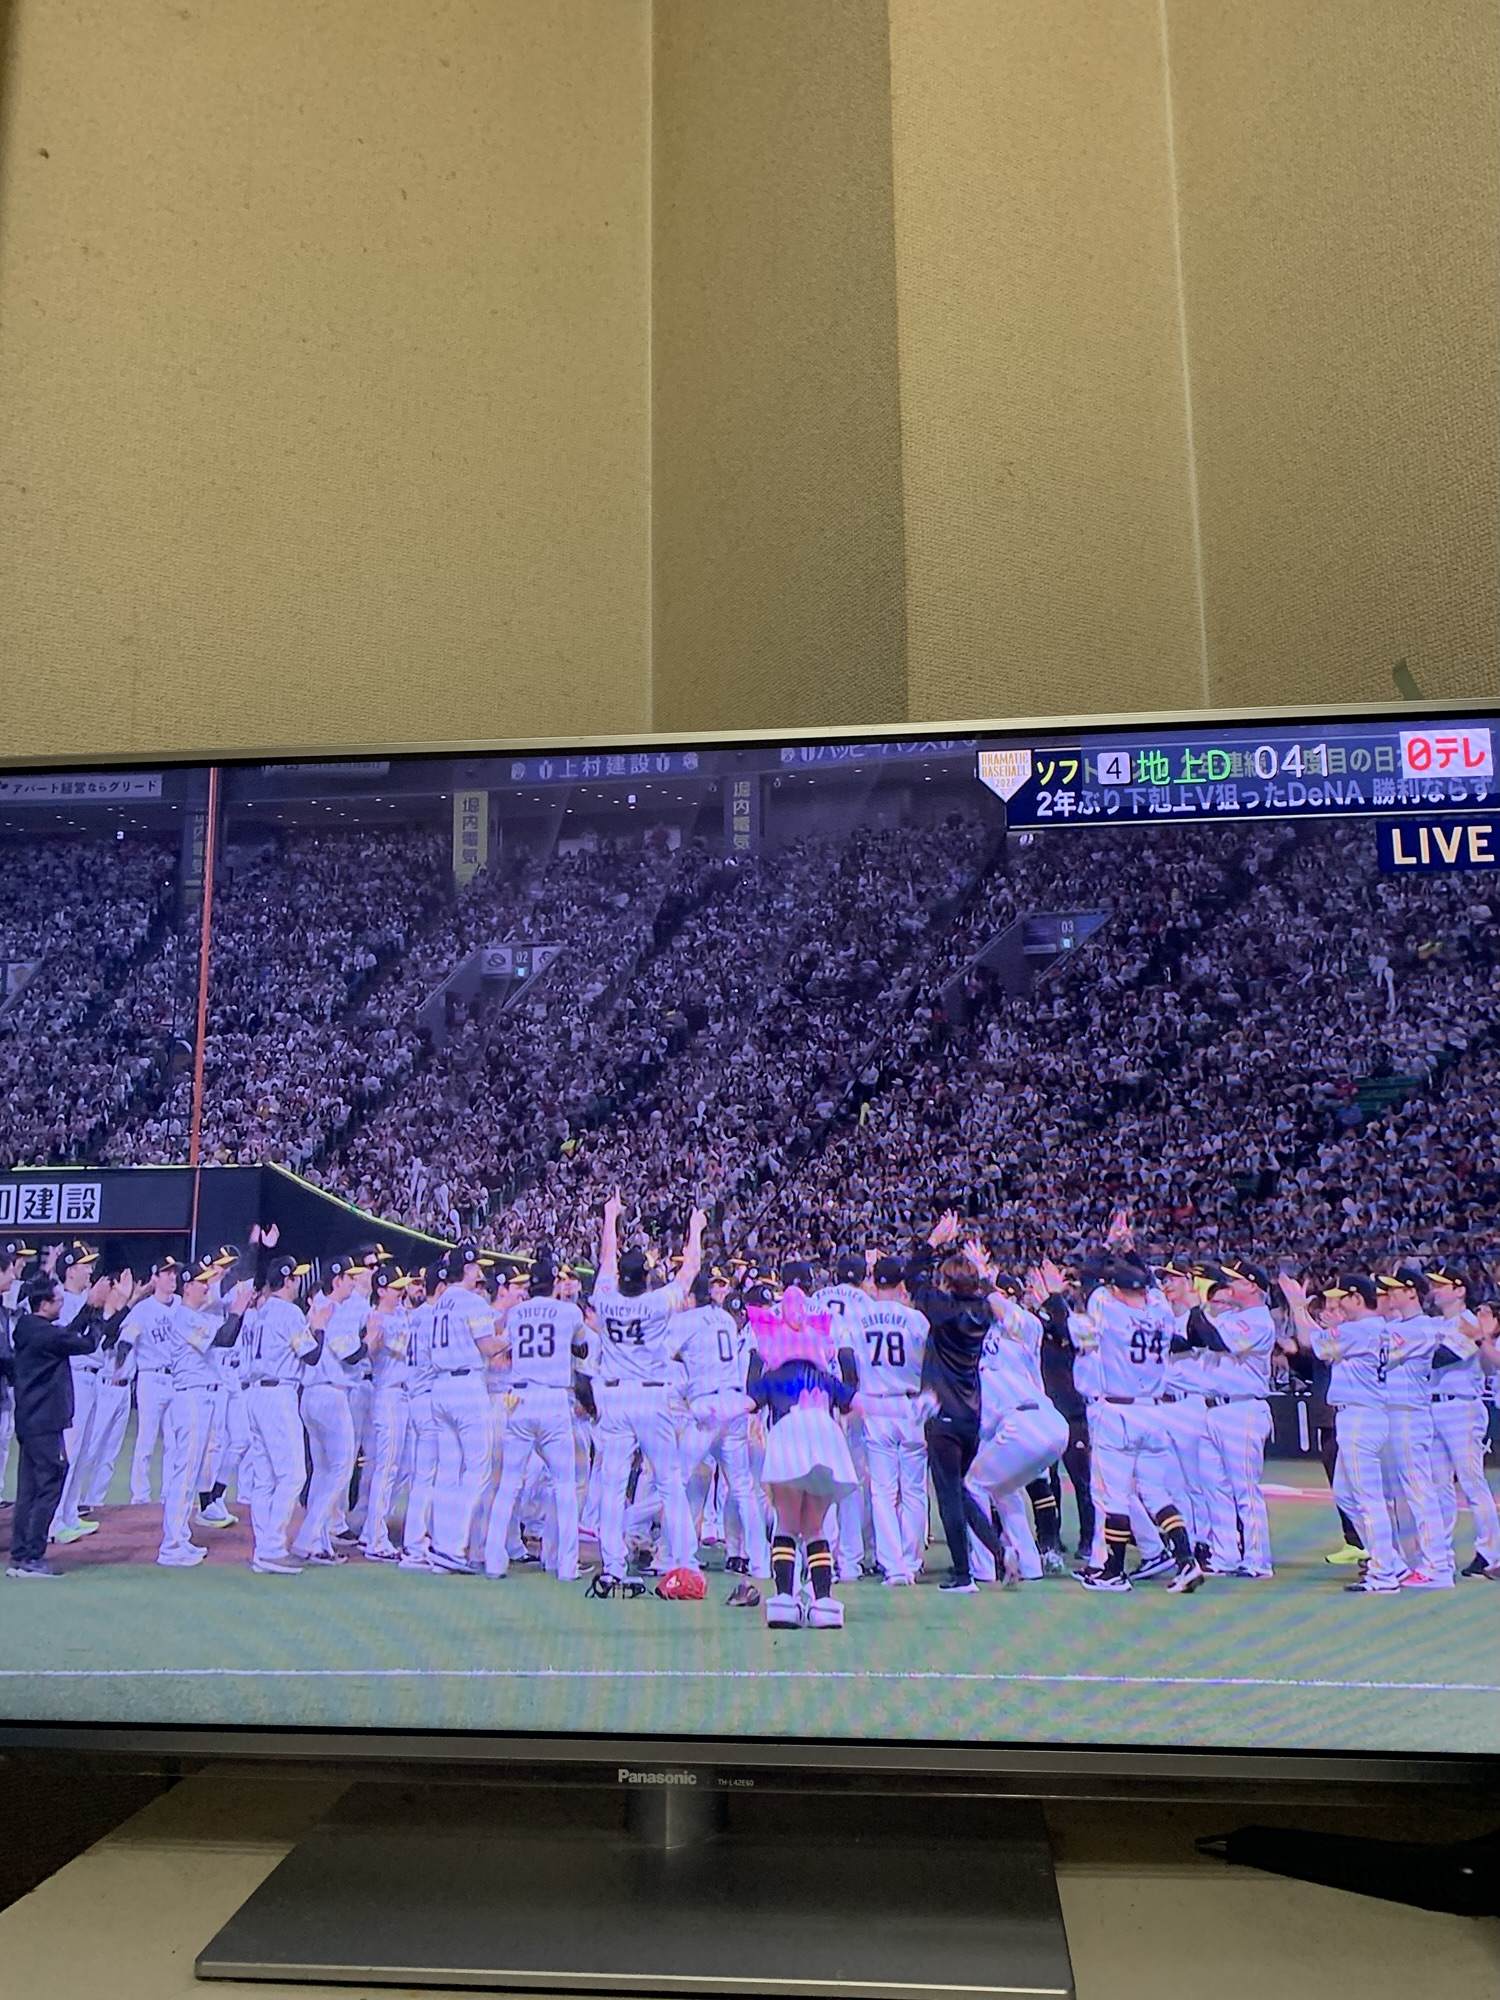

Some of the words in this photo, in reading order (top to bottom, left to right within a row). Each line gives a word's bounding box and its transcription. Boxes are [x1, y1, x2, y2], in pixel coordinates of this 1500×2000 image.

[559, 753, 649, 778] 上村建設
[981, 751, 1028, 765] DRAMATIC
[982, 765, 1028, 777] BASEBALL
[1254, 743, 1328, 779] 041
[1391, 825, 1495, 865] LIVE
[517, 1307, 557, 1320] SHUTO
[518, 1323, 555, 1359] 23
[605, 1317, 645, 1346] 64
[865, 1331, 906, 1367] 78
[1130, 1329, 1164, 1365] 94
[617, 1768, 697, 1785] Panasonic
[717, 1778, 755, 1787] TH-L42E60
